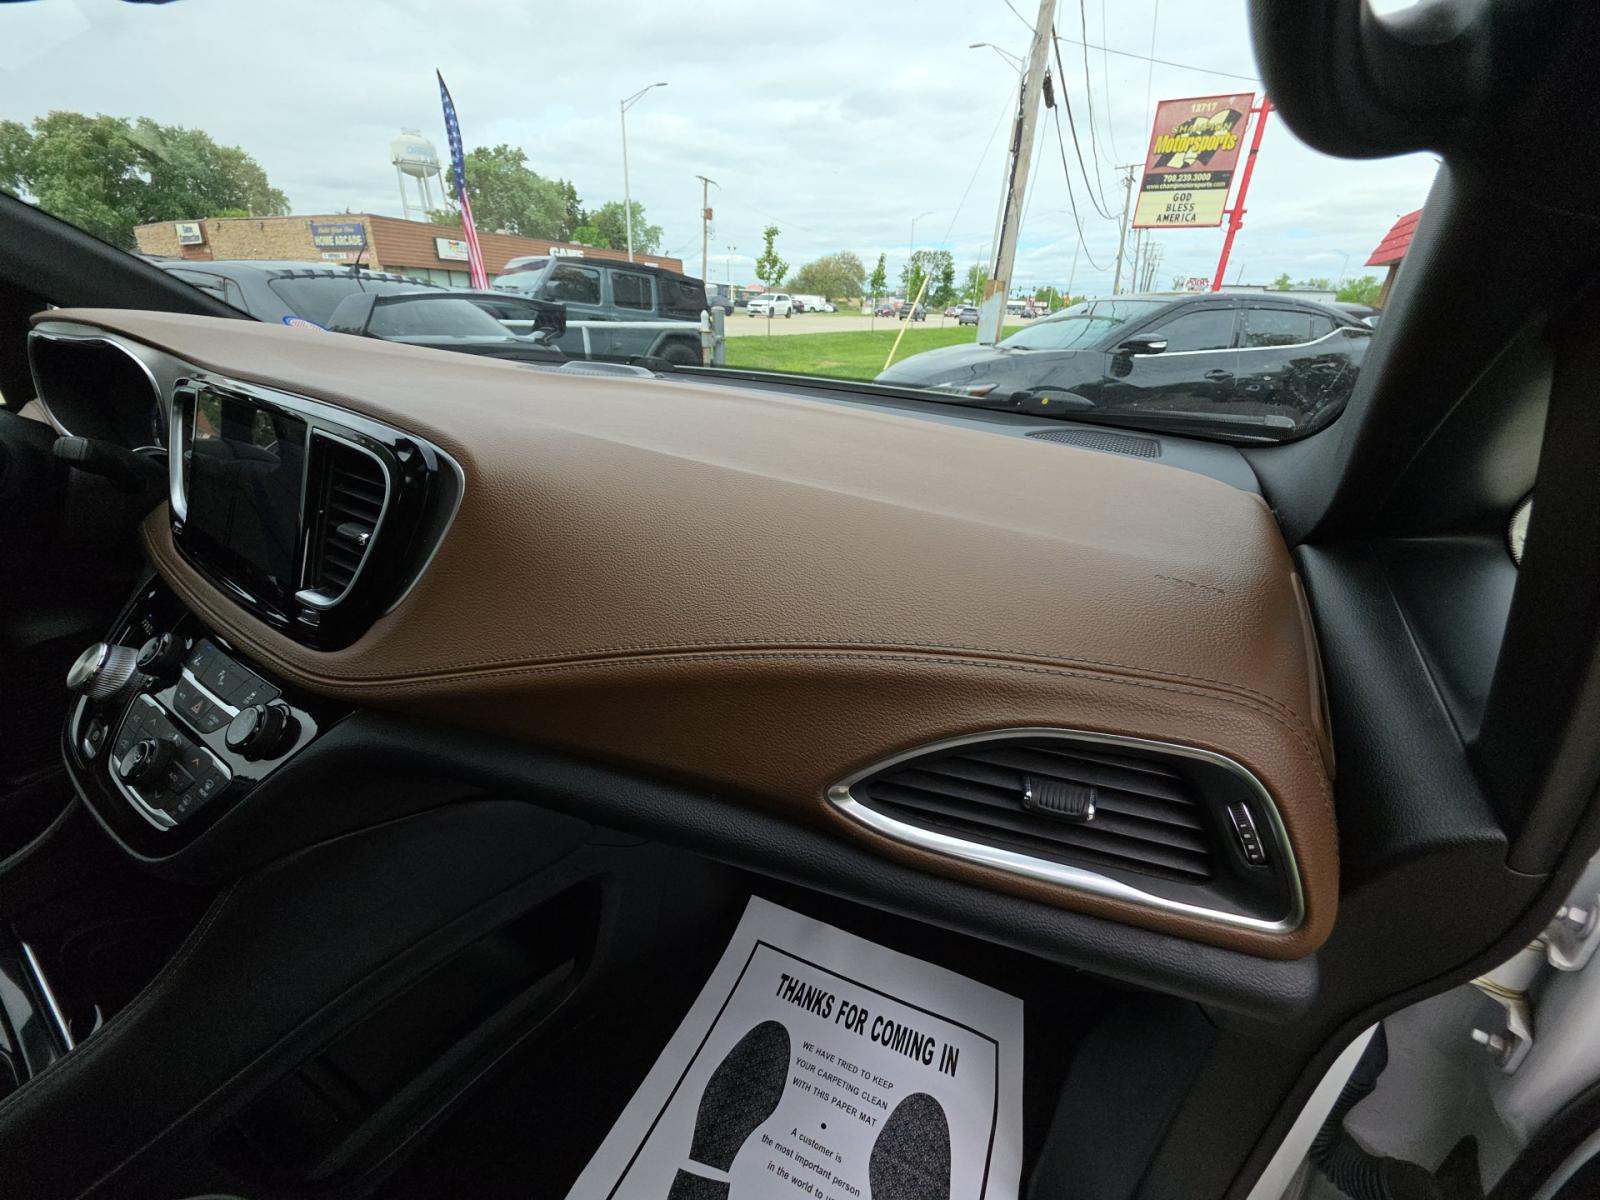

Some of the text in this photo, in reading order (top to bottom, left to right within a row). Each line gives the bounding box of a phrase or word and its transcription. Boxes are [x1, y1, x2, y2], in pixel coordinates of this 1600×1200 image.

[1154, 131, 1238, 154] Motorsports
[1163, 173, 1211, 182] 708.239.3000
[1166, 203, 1195, 212] BLESS
[1173, 193, 1192, 202] GOD
[1156, 213, 1196, 223] AMERICA
[776, 973, 960, 1078] THANKS FOR COMING IN
[795, 1057, 888, 1110] YOUR CARPETING CLEAN
[802, 1041, 894, 1090] WE HAVE TRIED TO KEEP
[792, 1076, 877, 1127] WITH THIS PAPER MAT
[790, 1127, 842, 1164] A customer is
[761, 1133, 861, 1198] the most important person
[766, 1160, 776, 1173] in
[776, 1166, 790, 1180] the
[791, 1176, 815, 1194] world
[814, 1188, 824, 1200] to
